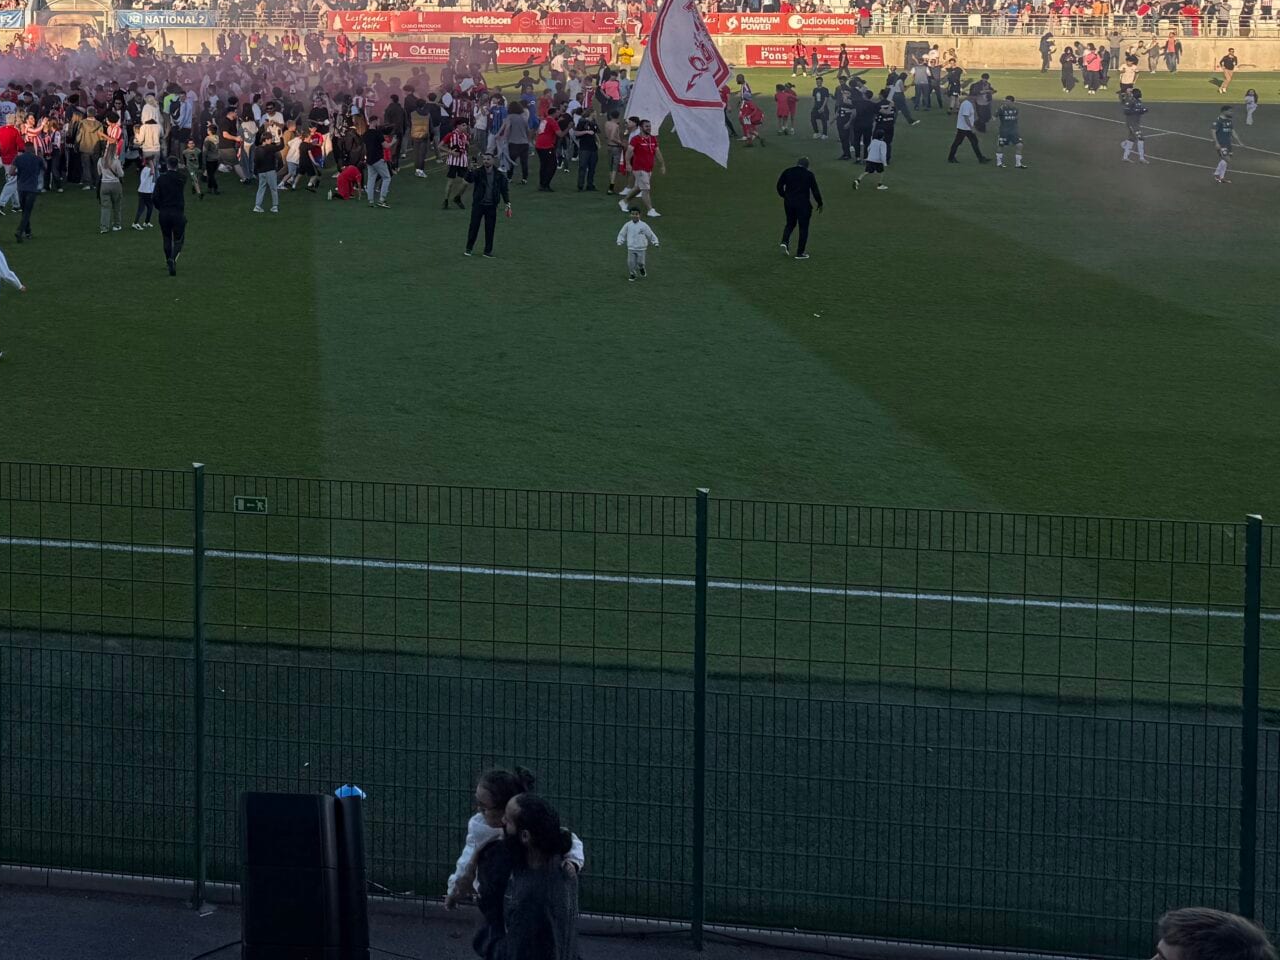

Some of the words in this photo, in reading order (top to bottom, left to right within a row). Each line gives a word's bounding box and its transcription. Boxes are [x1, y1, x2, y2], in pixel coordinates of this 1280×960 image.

[145, 15, 198, 24] NATIONAL
[198, 15, 206, 24] 2
[462, 16, 512, 25] tout&bon
[796, 15, 854, 26] audiovisions
[762, 52, 788, 60] Pons
